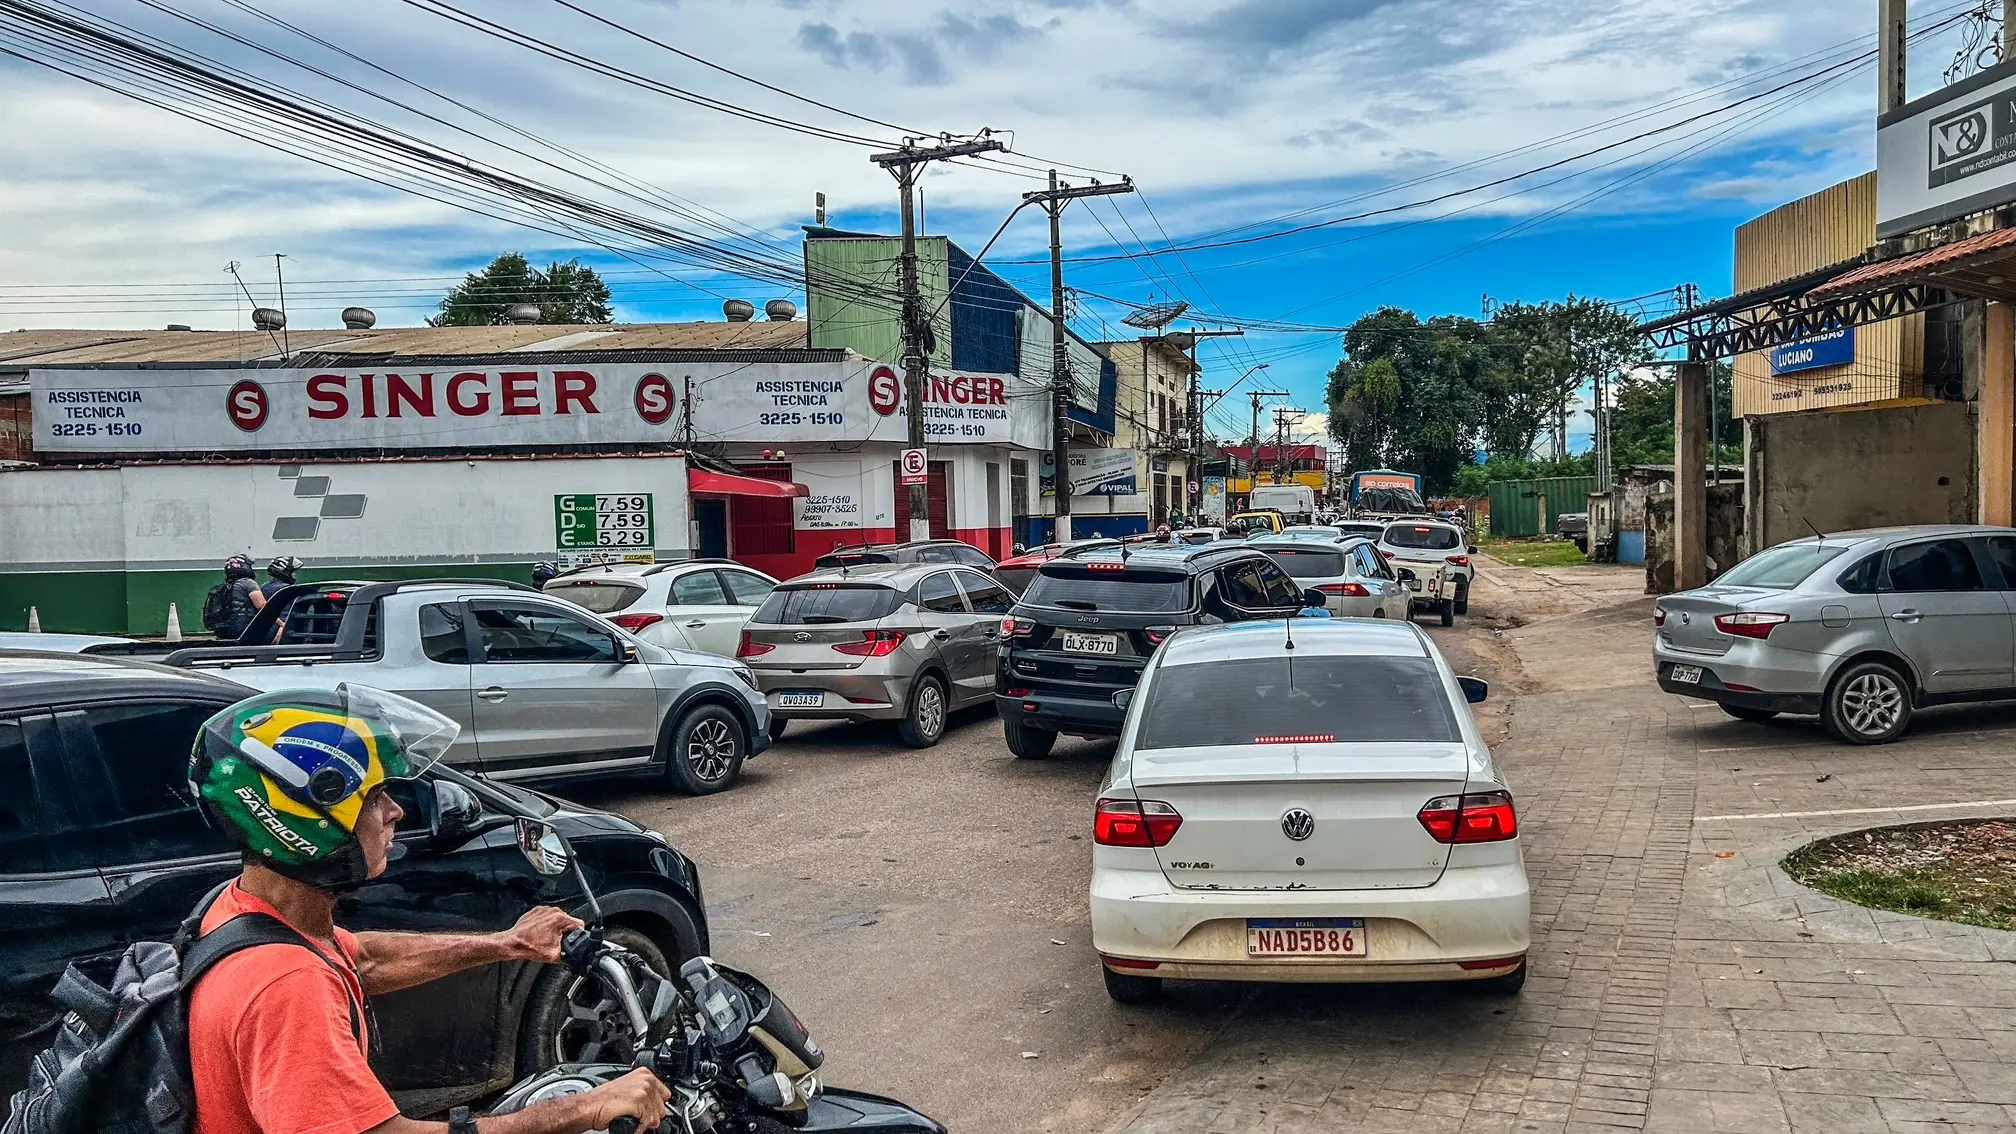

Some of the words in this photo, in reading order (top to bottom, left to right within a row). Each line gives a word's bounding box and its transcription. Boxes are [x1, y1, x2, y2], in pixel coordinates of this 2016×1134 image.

[1778, 347, 1814, 368] LUCIANO
[305, 370, 602, 420] SINGER
[904, 375, 1006, 405] INGER
[771, 394, 828, 406] TECNICA
[64, 406, 126, 419] TECNICA
[966, 408, 1007, 420] TECNICA
[559, 496, 576, 511] G
[561, 513, 577, 529] D
[561, 530, 575, 546] E
[1077, 615, 1100, 624] Jeep
[283, 737, 314, 746] ORDEM
[323, 745, 363, 773] PROGRESSO
[234, 786, 319, 856] PATRIOTA
[1258, 930, 1354, 952] NAD5B86
